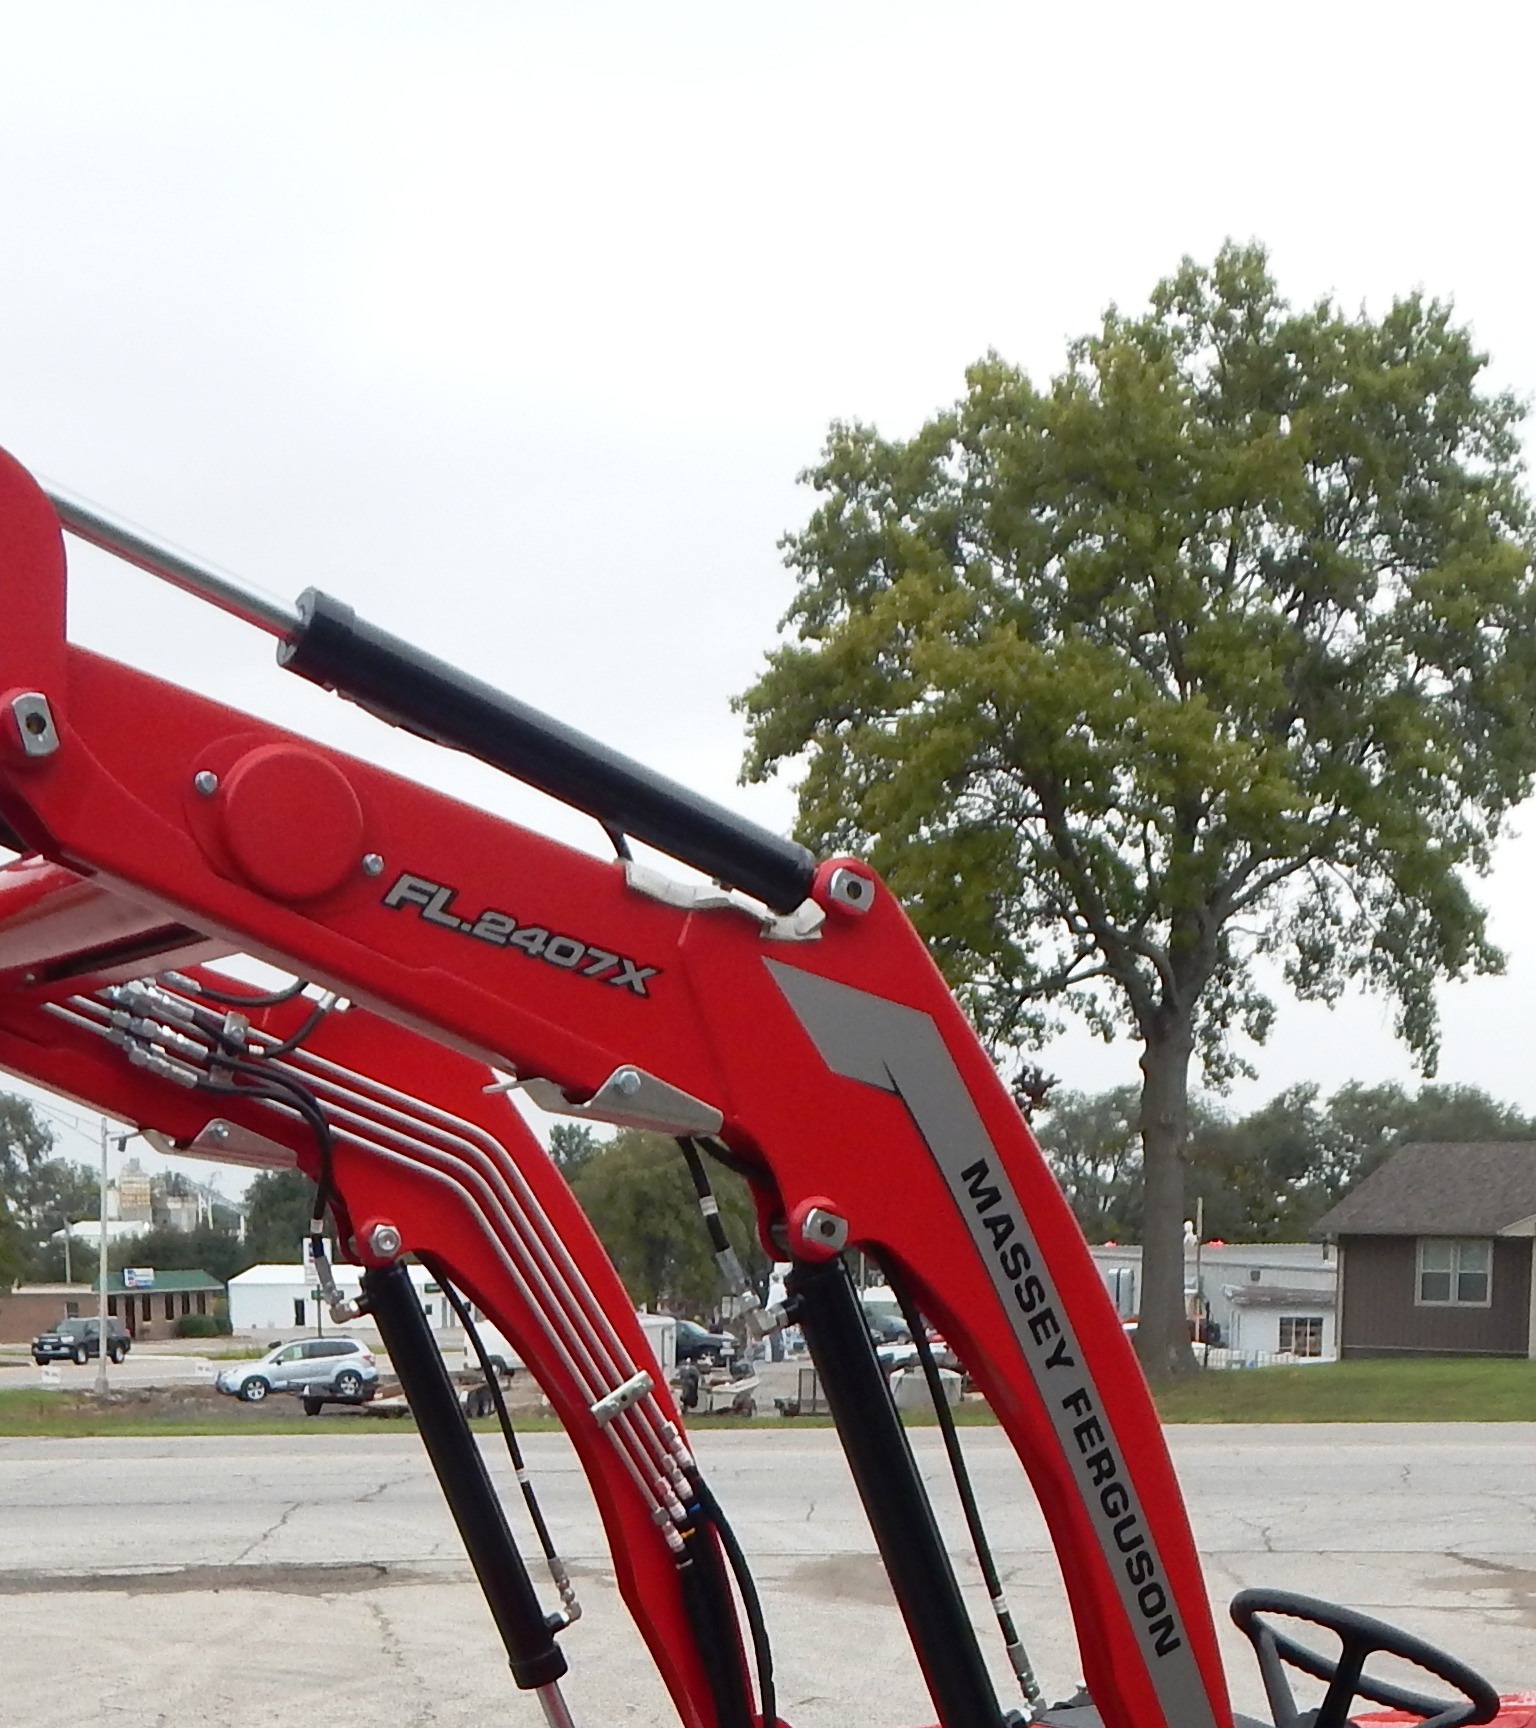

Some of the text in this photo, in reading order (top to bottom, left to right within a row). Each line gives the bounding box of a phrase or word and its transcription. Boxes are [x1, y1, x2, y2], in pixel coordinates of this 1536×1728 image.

[382, 871, 663, 998] FL.2407X
[960, 1156, 1182, 1658] MASSEY FERGUSON
